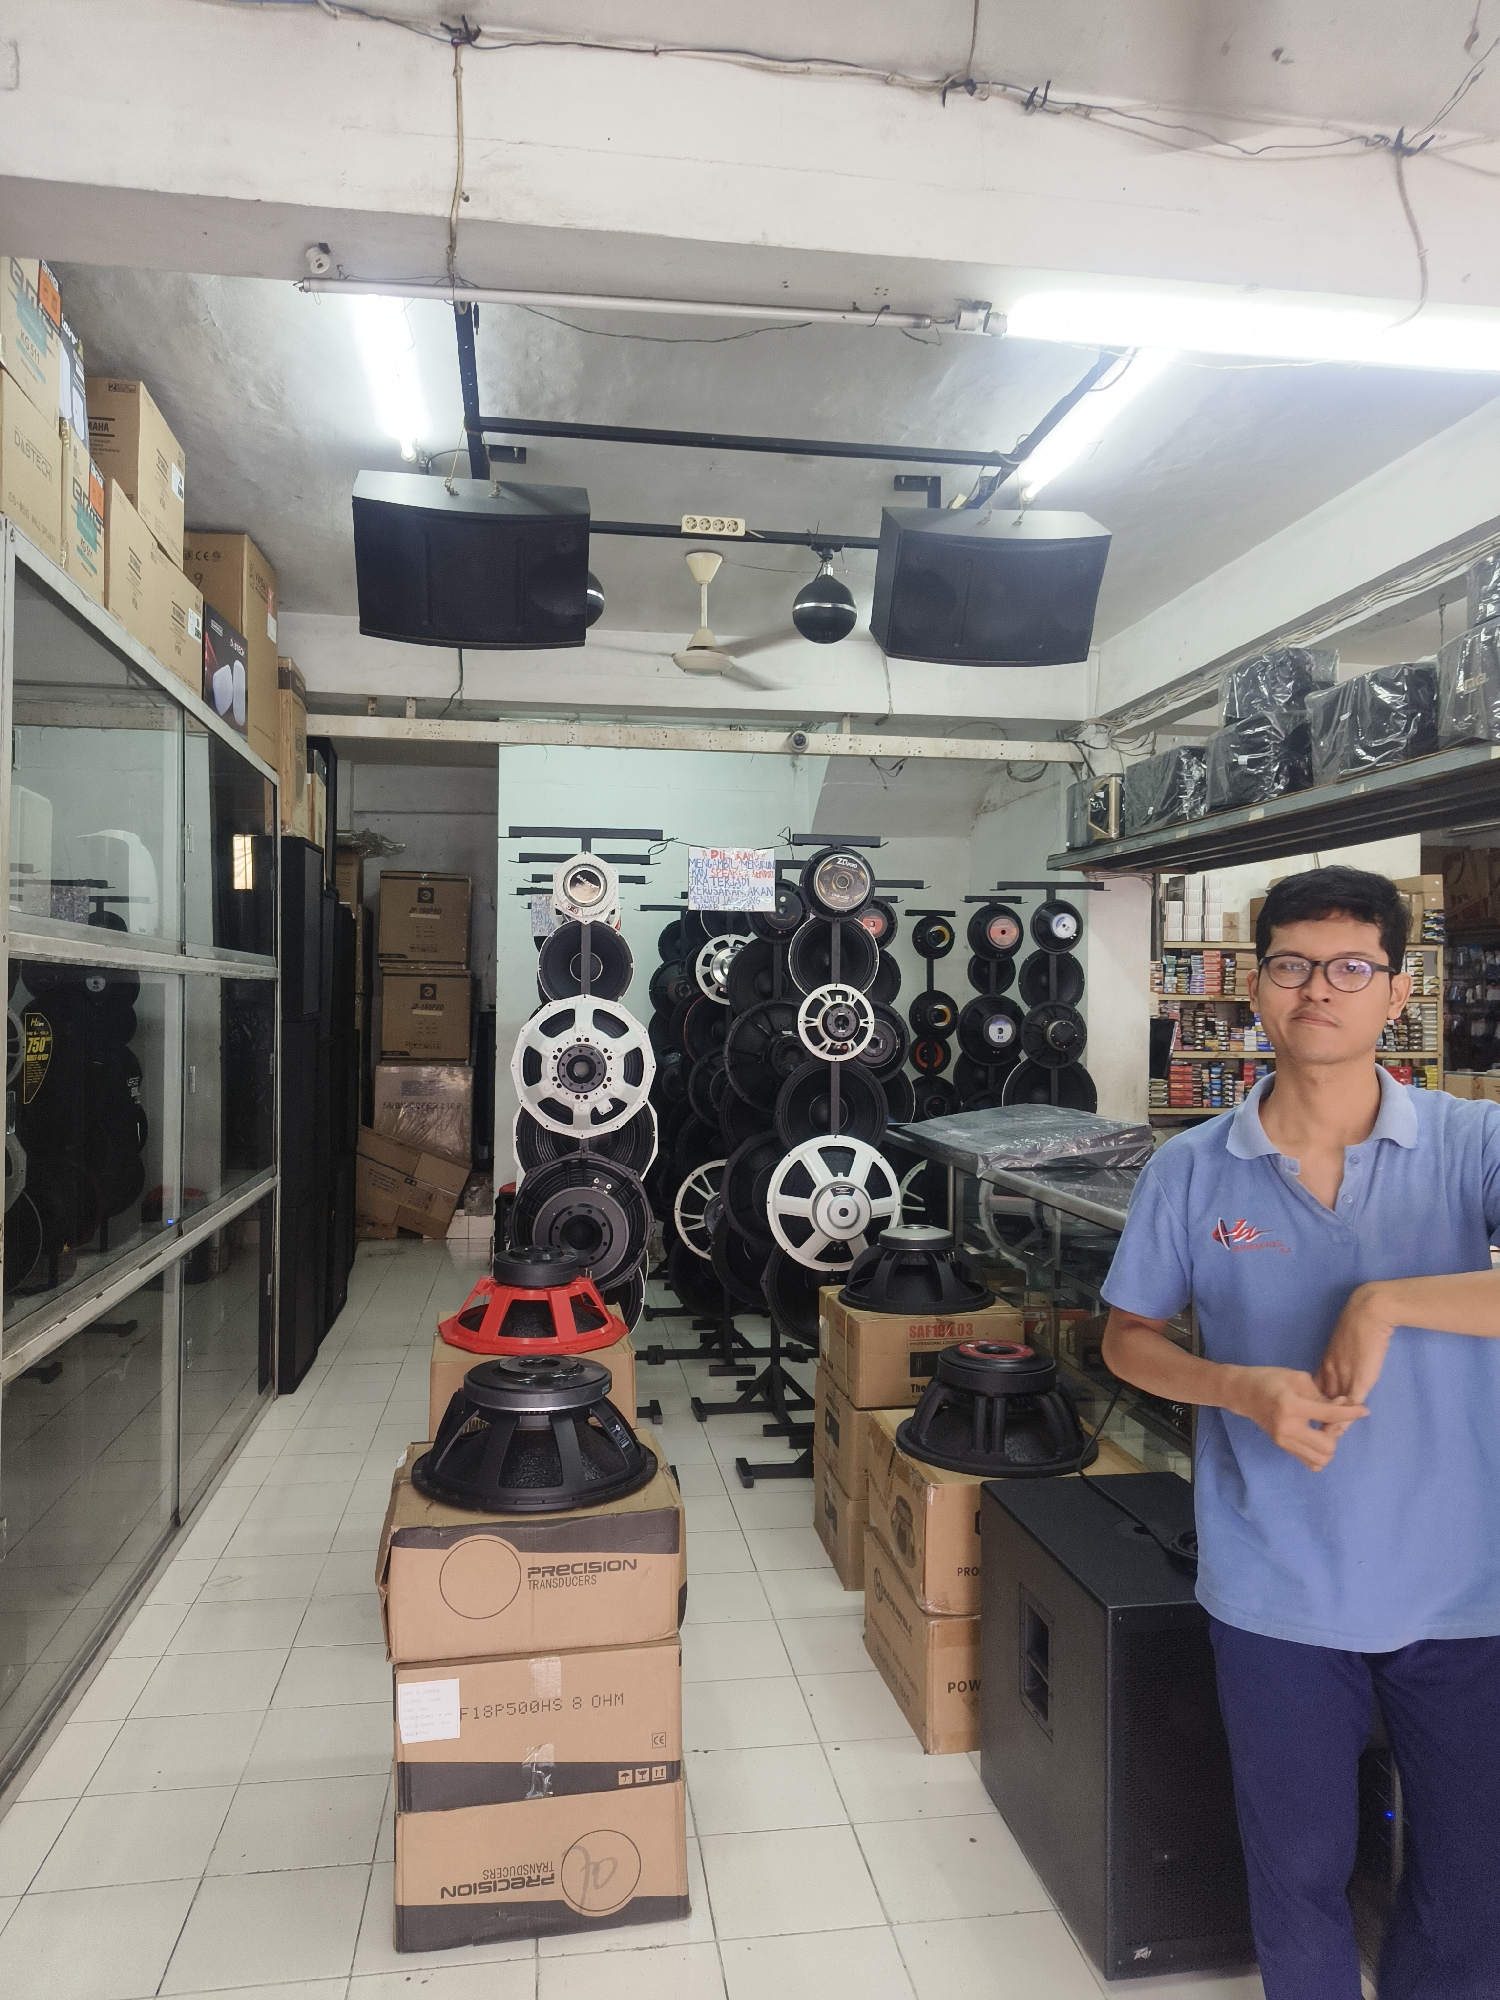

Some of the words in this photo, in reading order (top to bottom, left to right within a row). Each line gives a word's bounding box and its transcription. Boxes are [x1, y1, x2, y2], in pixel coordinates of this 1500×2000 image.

[527, 1559, 637, 1579] PRECISION
[528, 1574, 597, 1590] TRANSDUCERS
[572, 1696, 582, 1710] 8
[591, 1692, 624, 1708] OHM
[482, 1861, 555, 1880] TRANSDUCERS
[440, 1873, 555, 1899] PRECISION
